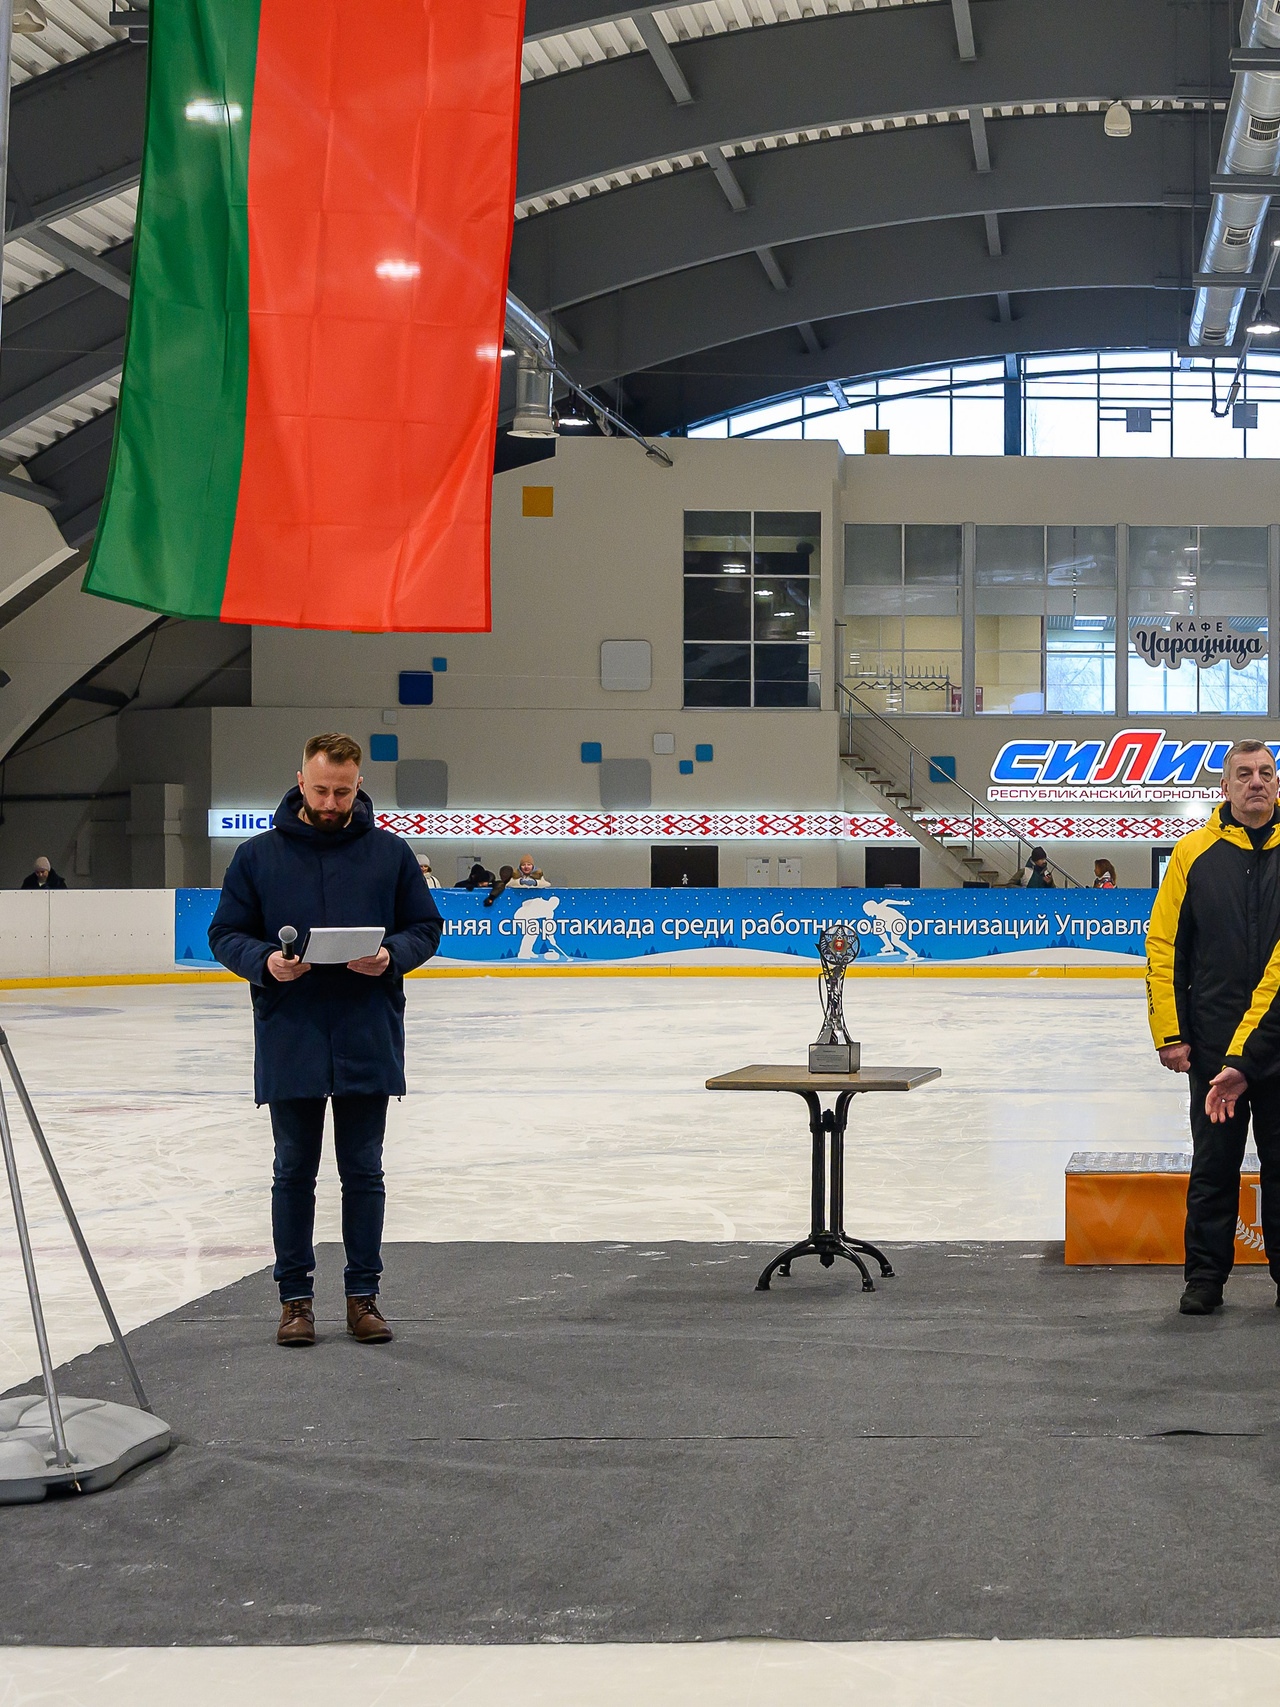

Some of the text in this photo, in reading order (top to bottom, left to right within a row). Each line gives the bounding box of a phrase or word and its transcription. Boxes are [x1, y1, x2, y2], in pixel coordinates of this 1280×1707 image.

[1176, 622, 1223, 632] КАФЕ
[990, 787, 1142, 799] РЕСПУБЛИКАНСКИЙ
[1145, 789, 1224, 799] ГОРНОЛЫЖ
[222, 814, 273, 829] silic
[442, 919, 491, 936] няя
[498, 918, 655, 940] спартакиада
[661, 918, 734, 940] среди
[892, 913, 1050, 940] организаций
[1055, 913, 1151, 940] Управле
